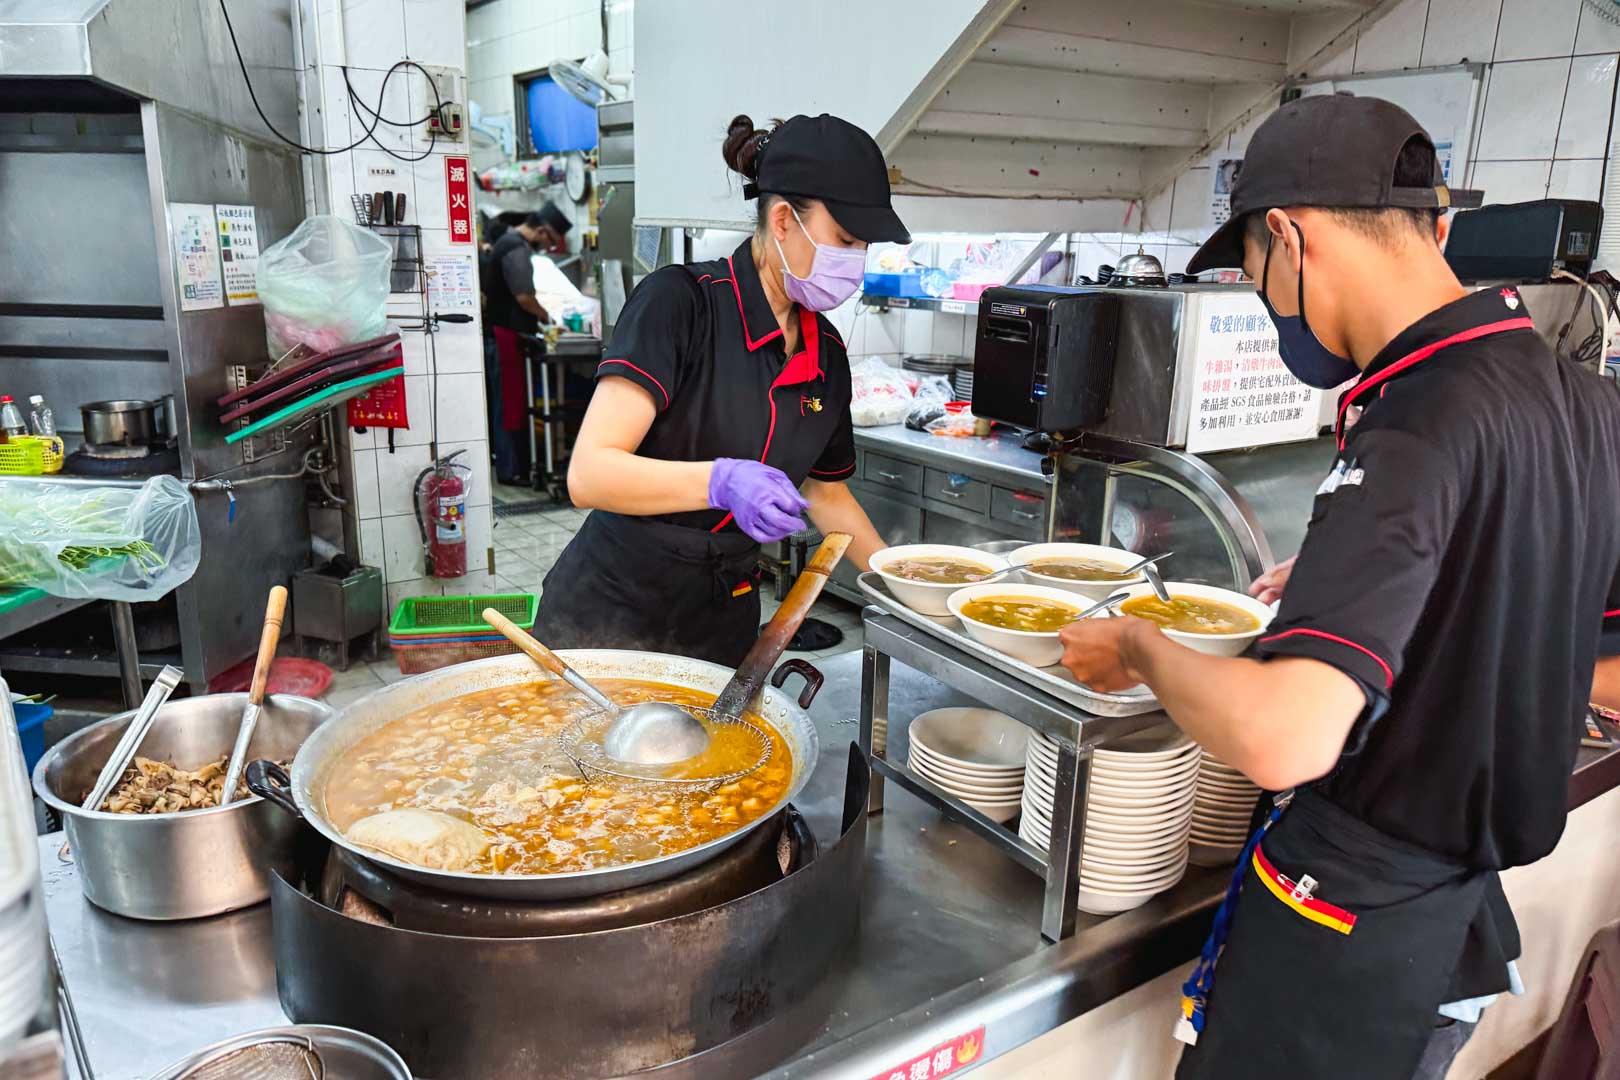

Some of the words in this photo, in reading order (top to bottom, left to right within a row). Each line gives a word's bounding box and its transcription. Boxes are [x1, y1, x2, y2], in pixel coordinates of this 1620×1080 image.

[450, 165, 469, 235] 滅火器
[1209, 314, 1271, 334] 敬愛的顧客:
[1235, 338, 1278, 354] 本店提供新
[1200, 396, 1229, 412] 產品經
[1231, 396, 1247, 408] SGS
